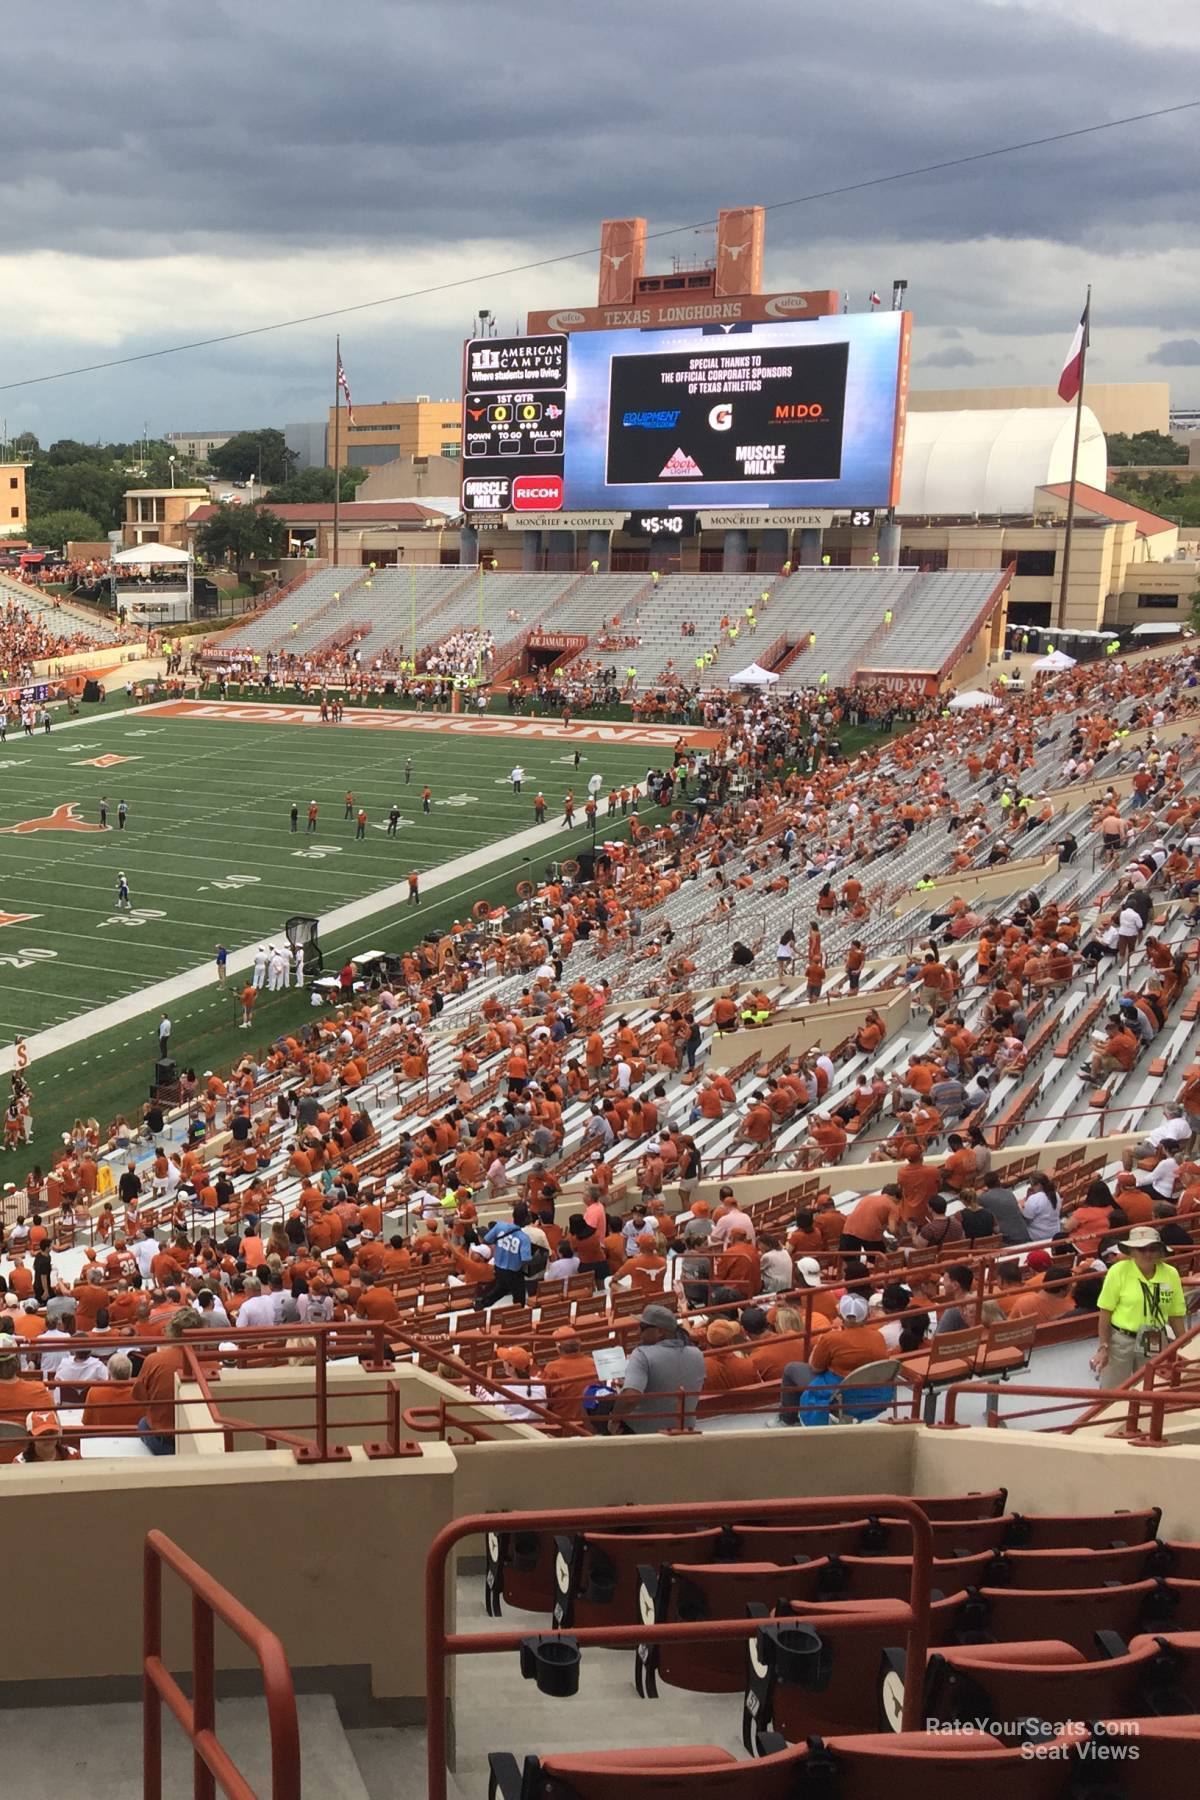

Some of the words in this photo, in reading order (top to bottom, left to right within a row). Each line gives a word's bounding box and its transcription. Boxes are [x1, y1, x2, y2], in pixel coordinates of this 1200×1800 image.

[604, 309, 650, 325] TEXAS
[657, 303, 742, 323] LONGHORNS
[501, 345, 562, 358] AMERICAN
[500, 356, 562, 368] CAMPUS
[689, 358, 719, 370] SPECIAL
[720, 356, 750, 368] THANKS
[751, 355, 761, 366] TO
[472, 371, 494, 382] Where
[495, 369, 524, 381] students
[525, 368, 539, 379] love
[661, 373, 674, 383] THE
[675, 371, 706, 382] OFFICIAL
[708, 368, 750, 381] CORPORATE
[752, 366, 793, 379] SPONSORS
[688, 383, 698, 394] OF
[699, 382, 722, 393] TEXAS
[723, 380, 761, 392] ATHLETICS
[497, 394, 512, 403] 1ST
[514, 394, 534, 403] QTR
[495, 406, 506, 421] 0
[523, 405, 535, 420] 0
[775, 404, 822, 418] MIDO
[550, 430, 562, 438] ON
[736, 445, 786, 461] MUSCLE
[744, 460, 776, 475] MILK
[466, 482, 508, 495] MUSCLE
[516, 488, 559, 498] RICOH
[474, 495, 500, 508] MILK
[570, 518, 614, 526] COMPLEX
[641, 516, 683, 534] 45:40
[711, 516, 760, 525] MONCRIEF
[772, 516, 821, 525] COMPLEX
[530, 636, 540, 647] JOE
[542, 636, 566, 648] JAMAIL
[178, 705, 699, 745] LONGHORNS
[290, 844, 343, 859] 50
[211, 874, 263, 891] 40
[106, 908, 167, 928] 30
[17, 1043, 28, 1067] S
